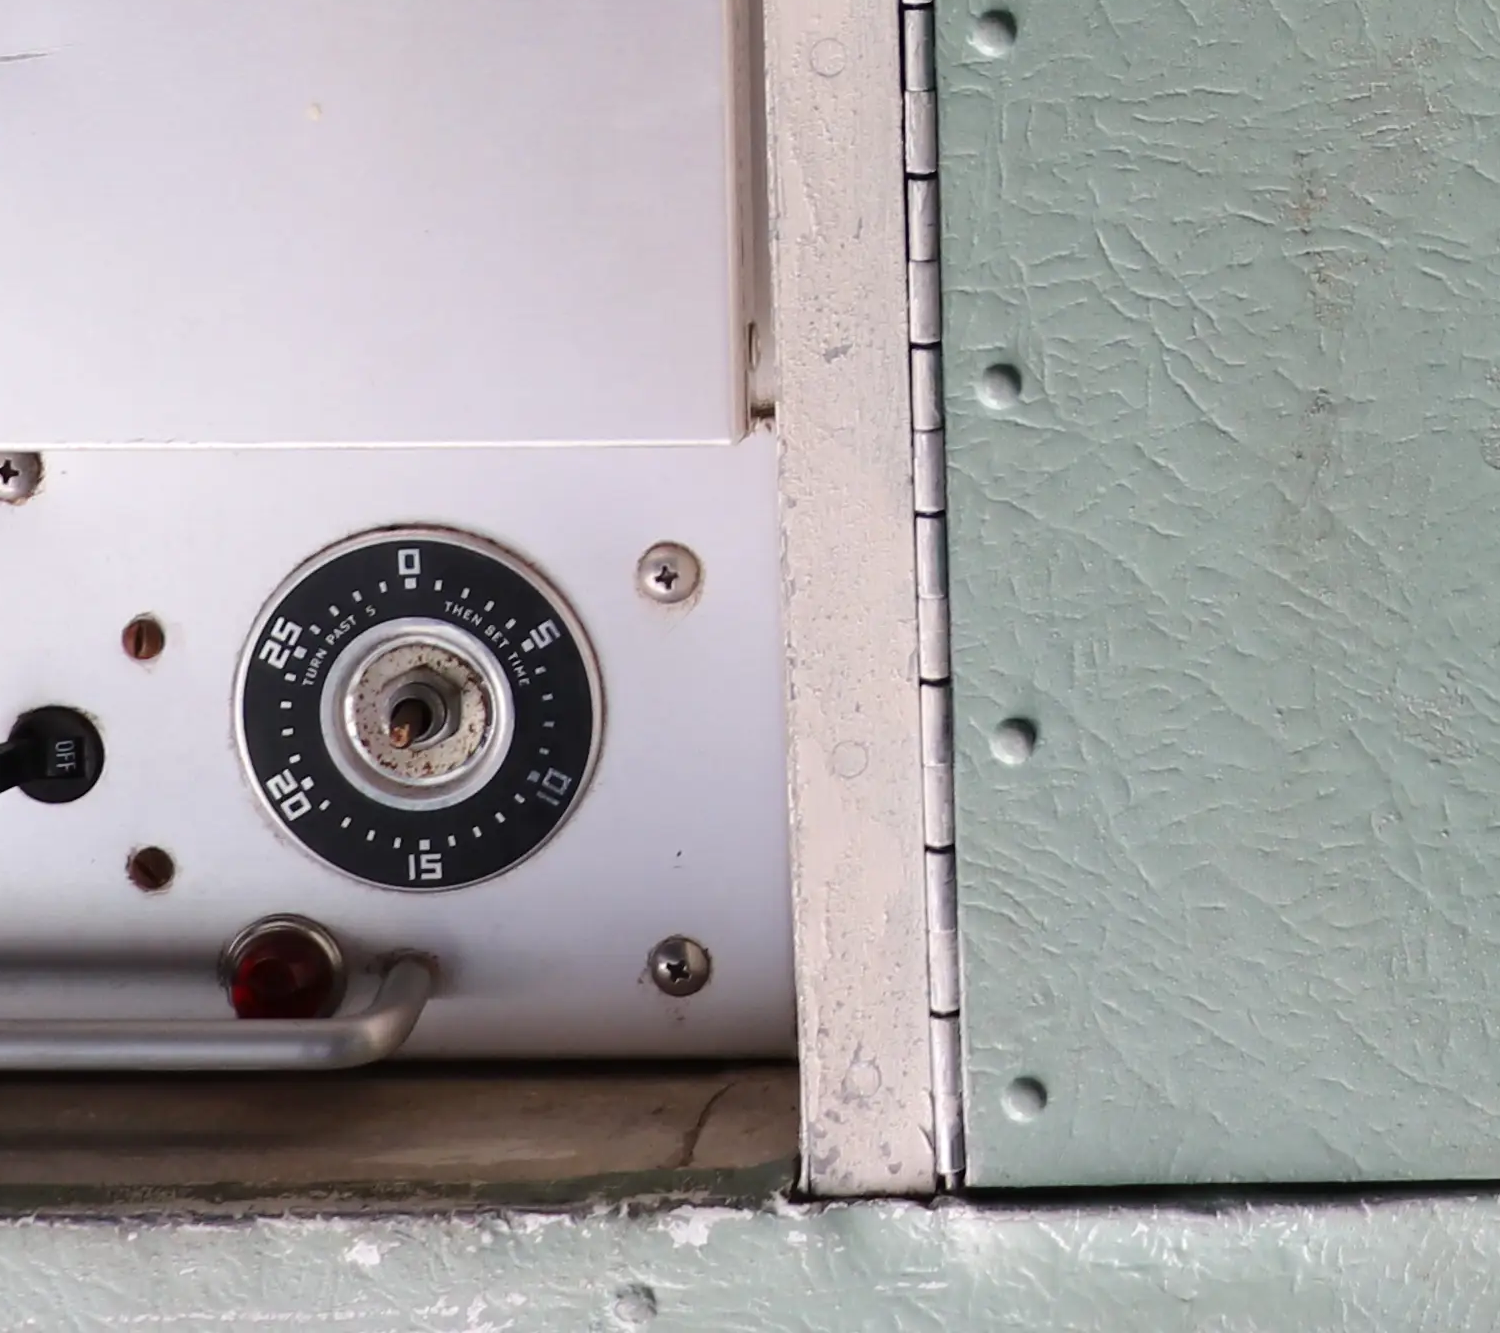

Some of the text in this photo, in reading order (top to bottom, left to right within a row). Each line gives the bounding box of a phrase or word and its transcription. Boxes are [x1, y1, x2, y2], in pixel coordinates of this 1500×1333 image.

[397, 548, 421, 577] 0
[259, 616, 303, 669] 25
[302, 648, 328, 686] TURN
[325, 614, 357, 645] PAST
[444, 600, 531, 687] THEN SET TIME
[529, 619, 561, 650] 5
[55, 740, 77, 774] OFF
[266, 770, 312, 821] 20
[536, 767, 573, 806] 10
[408, 853, 443, 881] 15
